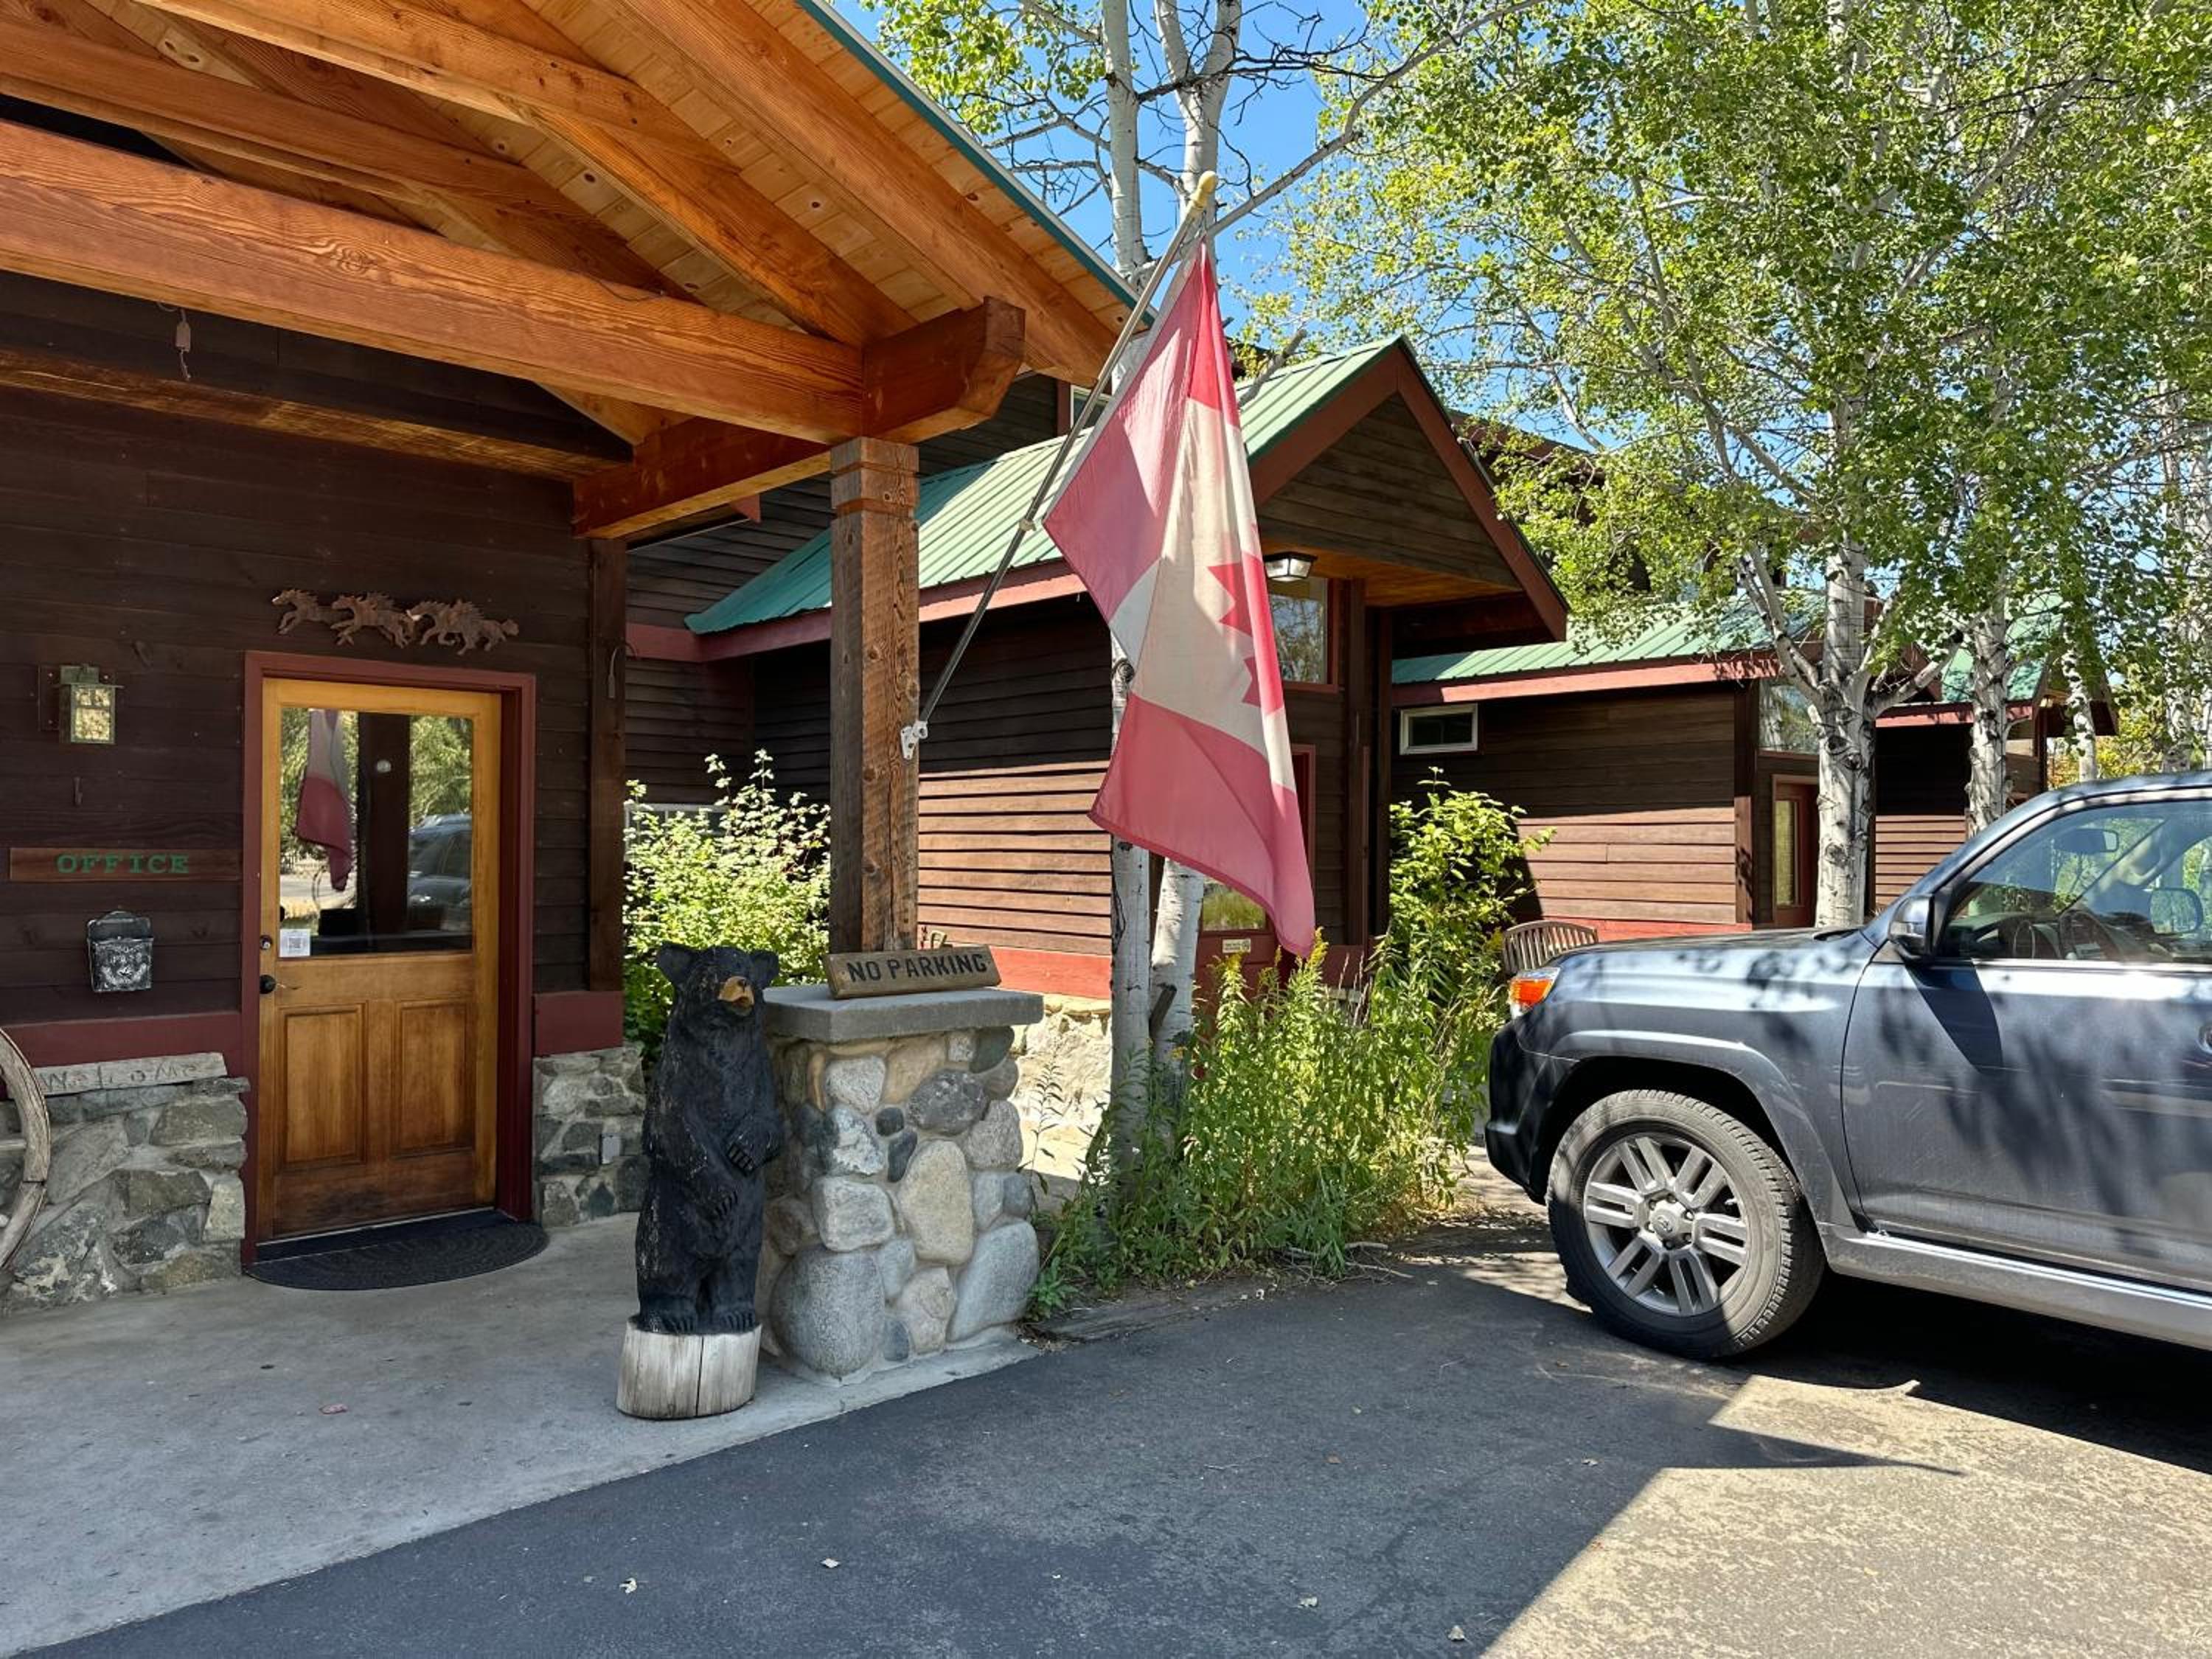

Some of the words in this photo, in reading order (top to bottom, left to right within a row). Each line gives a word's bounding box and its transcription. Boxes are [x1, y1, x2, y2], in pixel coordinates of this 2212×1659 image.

[57, 854, 189, 874] OFFICE
[848, 961, 881, 982] NO
[886, 953, 987, 979] PARKING
